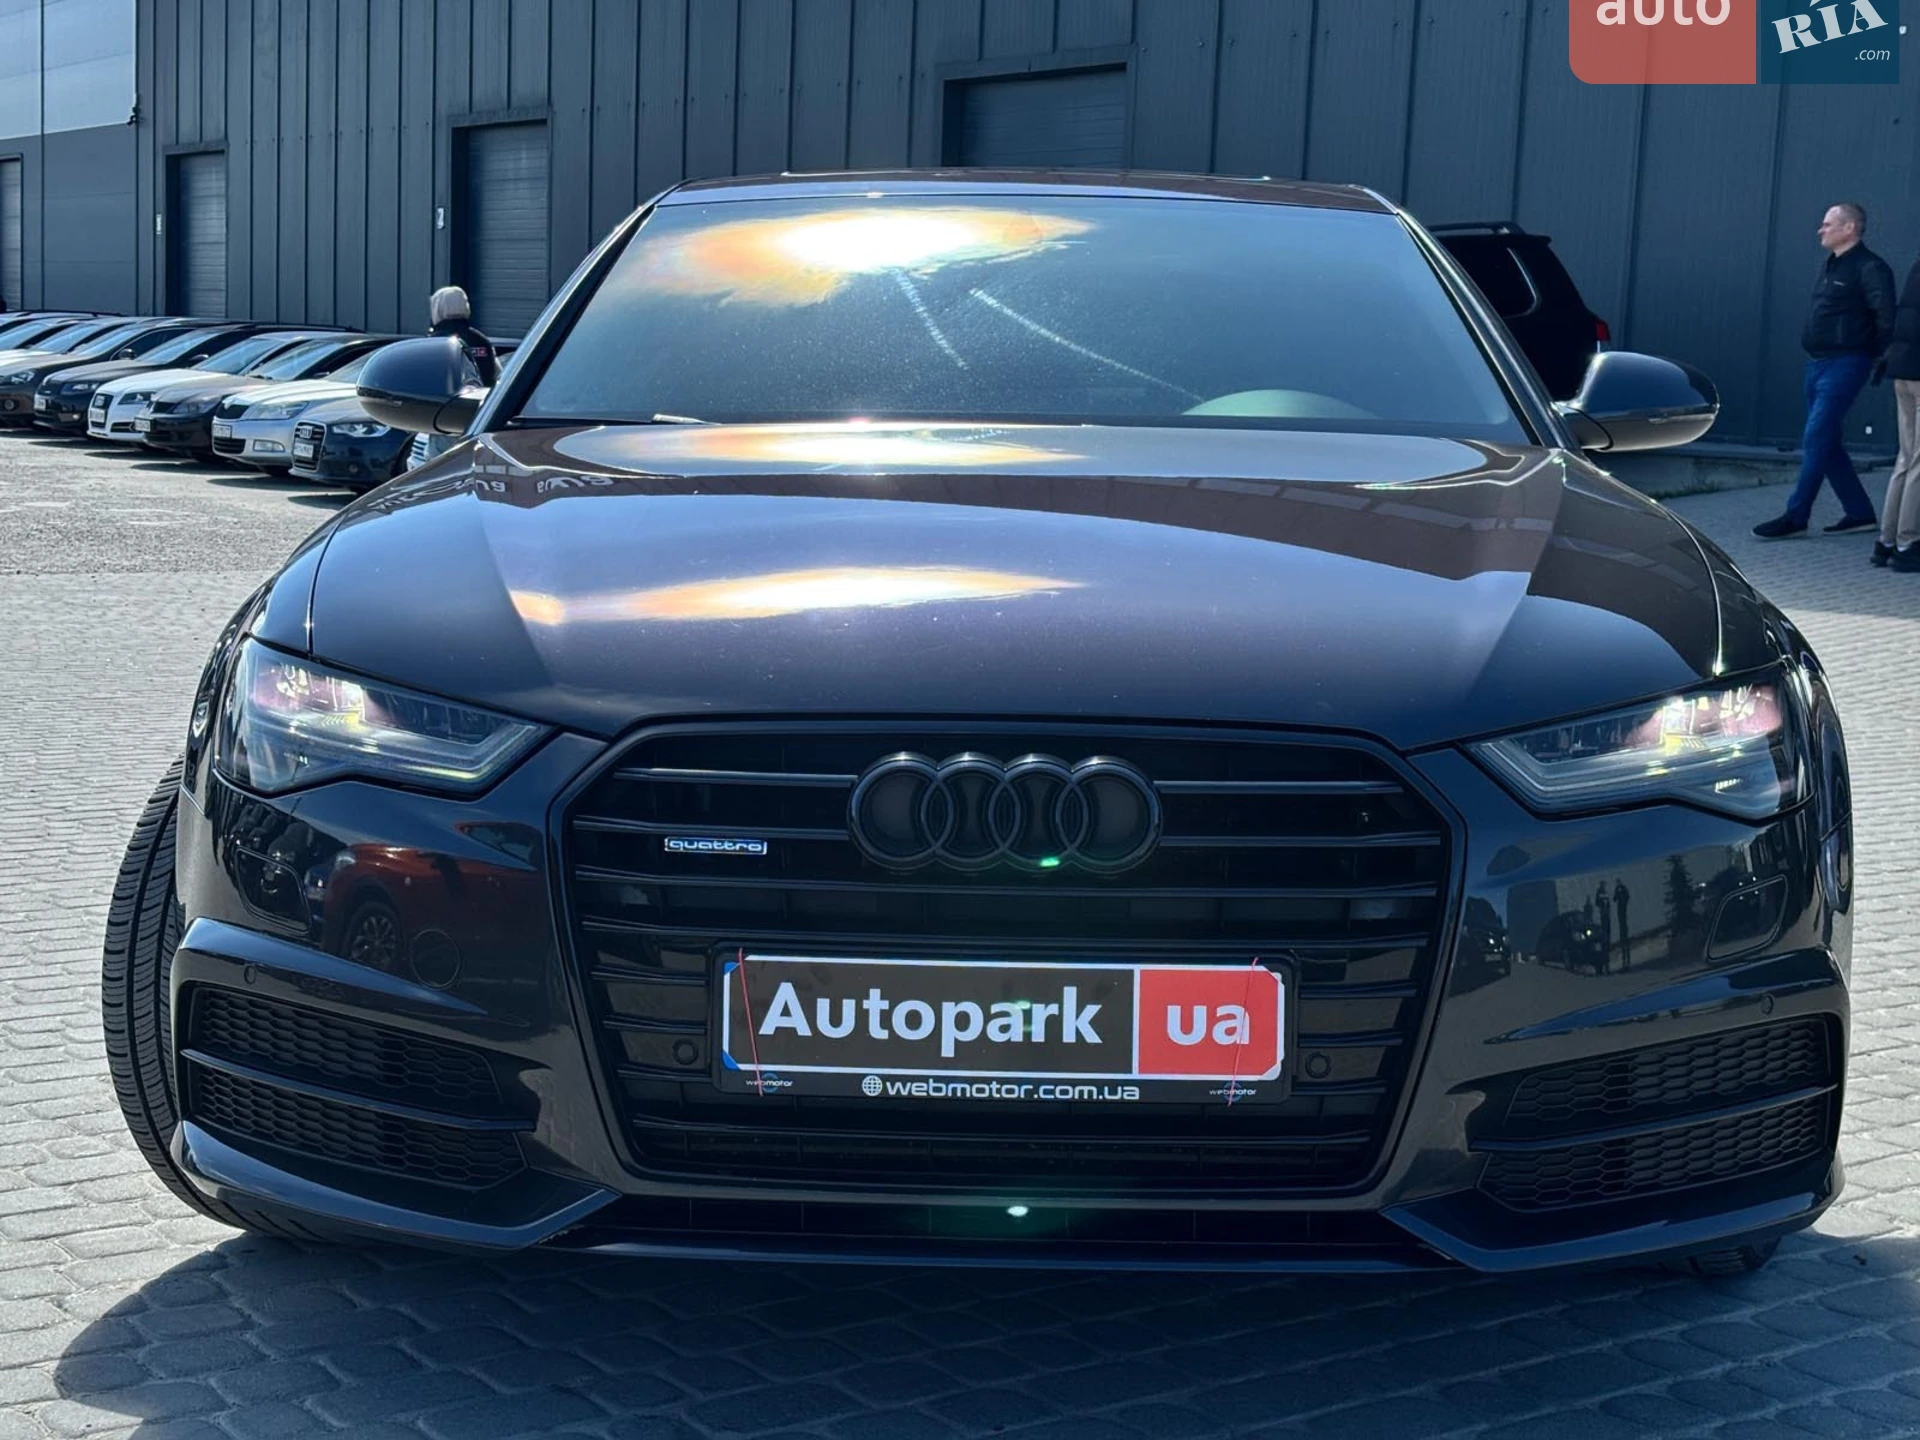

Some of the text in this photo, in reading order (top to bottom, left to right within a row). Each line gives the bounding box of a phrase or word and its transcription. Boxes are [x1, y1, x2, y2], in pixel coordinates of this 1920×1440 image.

[669, 840, 762, 851] quattro
[758, 982, 1250, 1057] Autopark ua
[886, 1078, 1140, 1100] webmotor.com.ua
